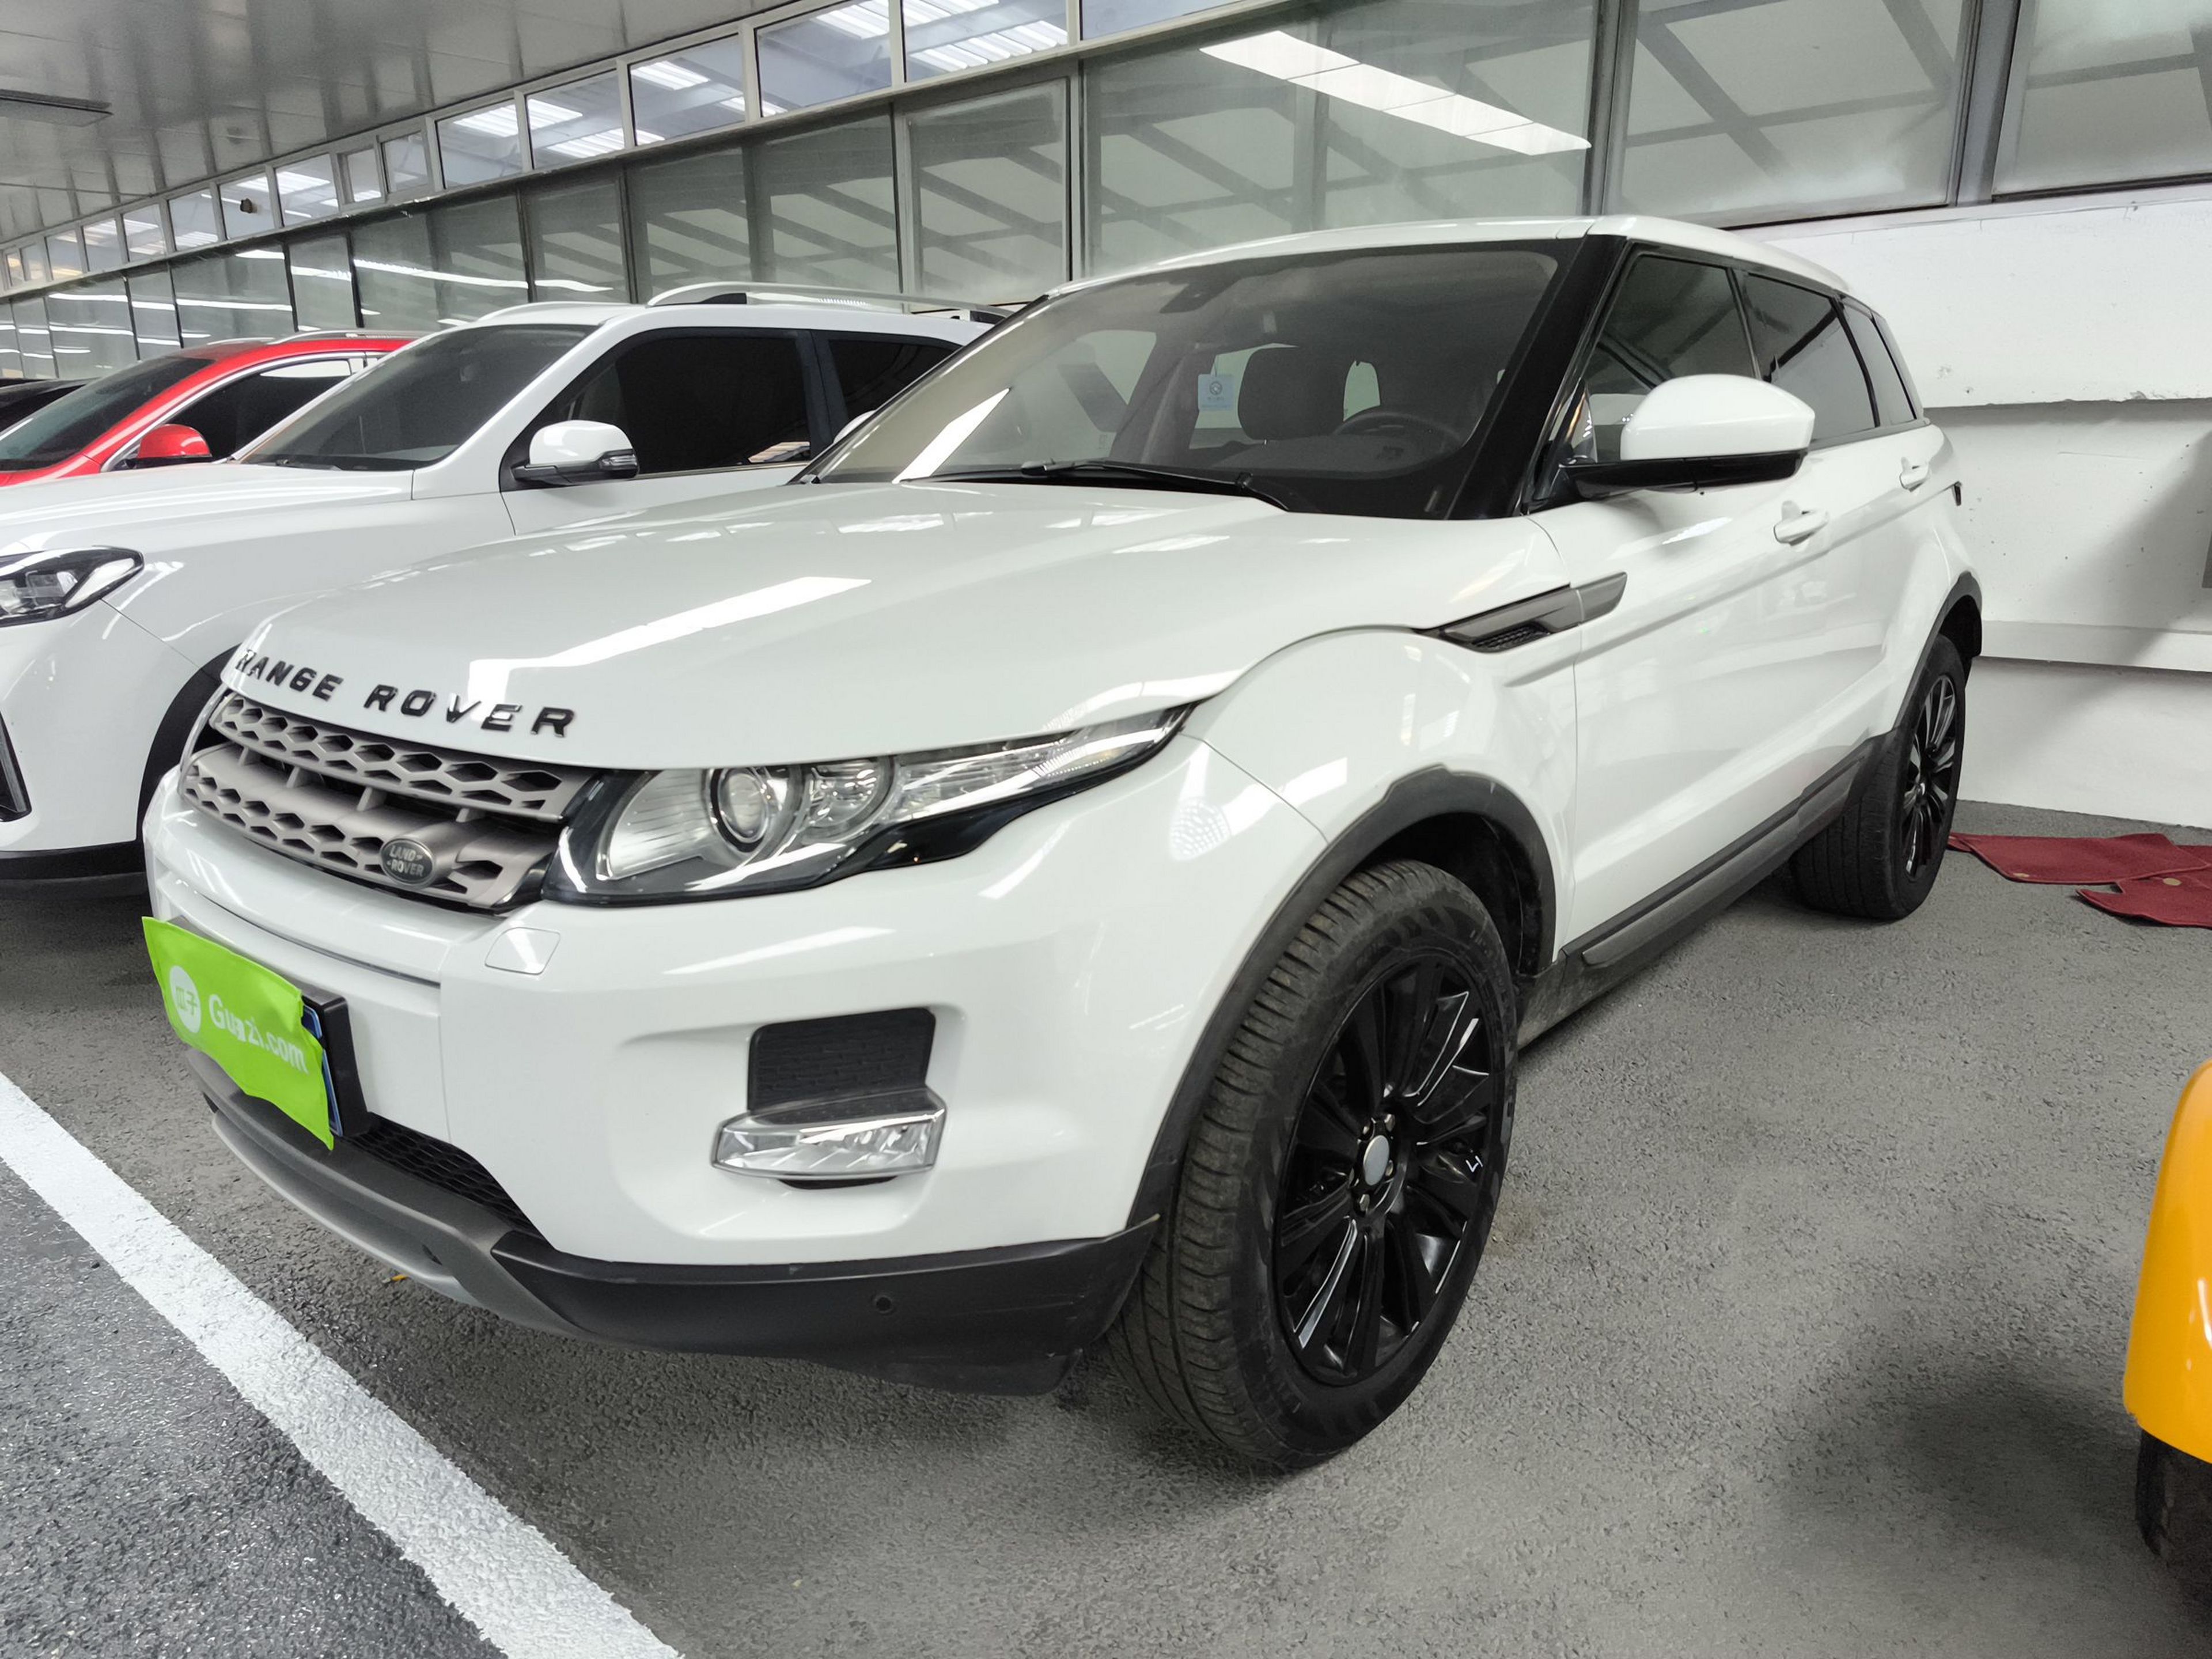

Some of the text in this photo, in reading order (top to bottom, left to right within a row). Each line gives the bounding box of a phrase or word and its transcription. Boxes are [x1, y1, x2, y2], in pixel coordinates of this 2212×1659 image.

[235, 649, 575, 738] RANGE ROVER
[389, 845, 416, 862] LAND
[391, 858, 425, 877] ROVER
